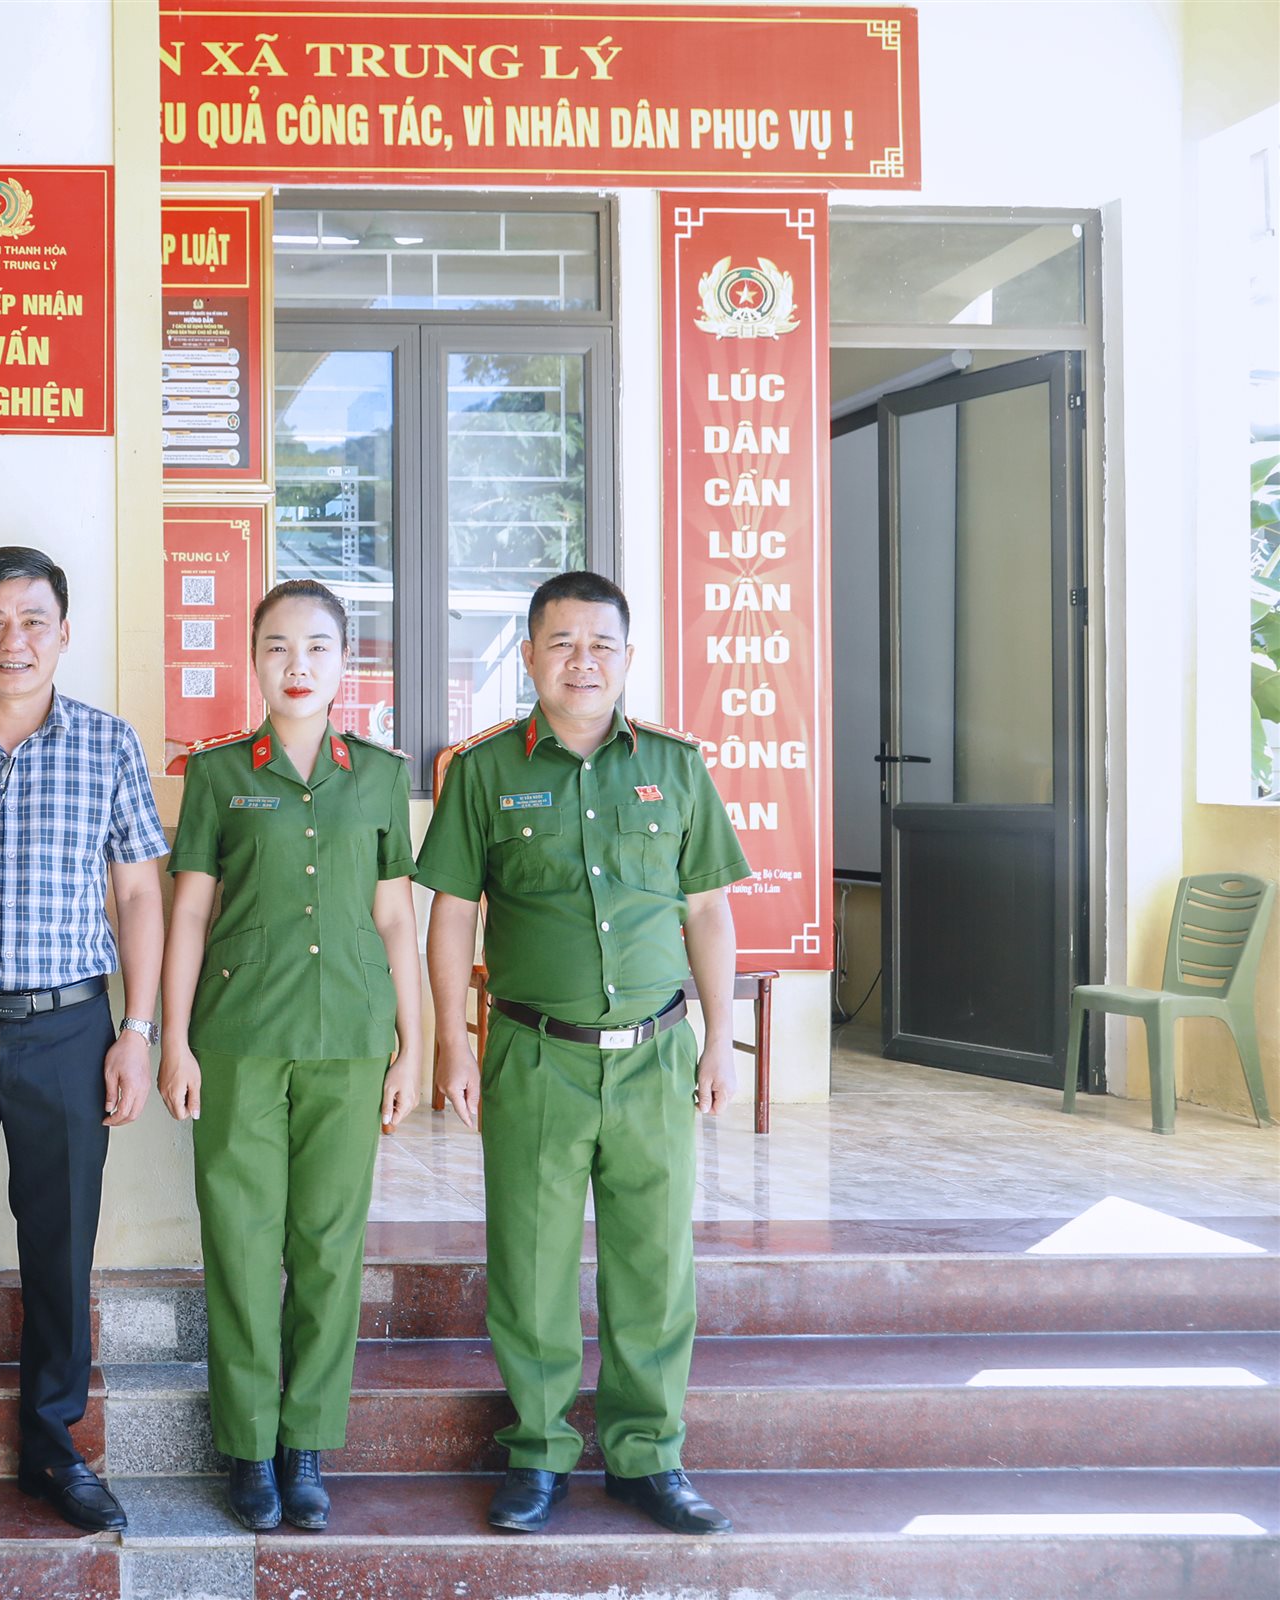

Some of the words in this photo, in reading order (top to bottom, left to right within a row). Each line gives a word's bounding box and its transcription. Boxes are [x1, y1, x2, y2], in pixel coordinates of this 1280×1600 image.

[201, 33, 289, 77] XÃ
[305, 42, 525, 80] TRUNG
[539, 35, 624, 81] LÝ
[197, 85, 267, 149] QUẢ
[276, 97, 370, 147] CÔNG
[378, 95, 453, 152] TÁC,
[462, 95, 496, 148] VÌ
[504, 97, 601, 149] NHÂN
[609, 98, 682, 150] DÂN
[690, 108, 779, 159] PHỤC
[788, 109, 832, 160] VỤ
[3, 260, 41, 270] TRUNG
[43, 259, 58, 271] LÝ
[4, 245, 41, 256] THANH
[162, 233, 177, 266] P
[181, 226, 231, 273] LUẬT
[22, 289, 83, 321] NHẬN
[707, 367, 786, 402] LÚC
[704, 420, 790, 454] DÂN
[704, 468, 791, 507] CẦN
[170, 551, 213, 562] TRUNG
[215, 550, 231, 562] LÝ
[708, 524, 786, 559] LÚC
[705, 577, 791, 612] DÂN
[706, 630, 790, 664] KHÓ
[721, 682, 776, 717] CÓ
[700, 735, 807, 769] CÔNG
[725, 802, 778, 830] AN
